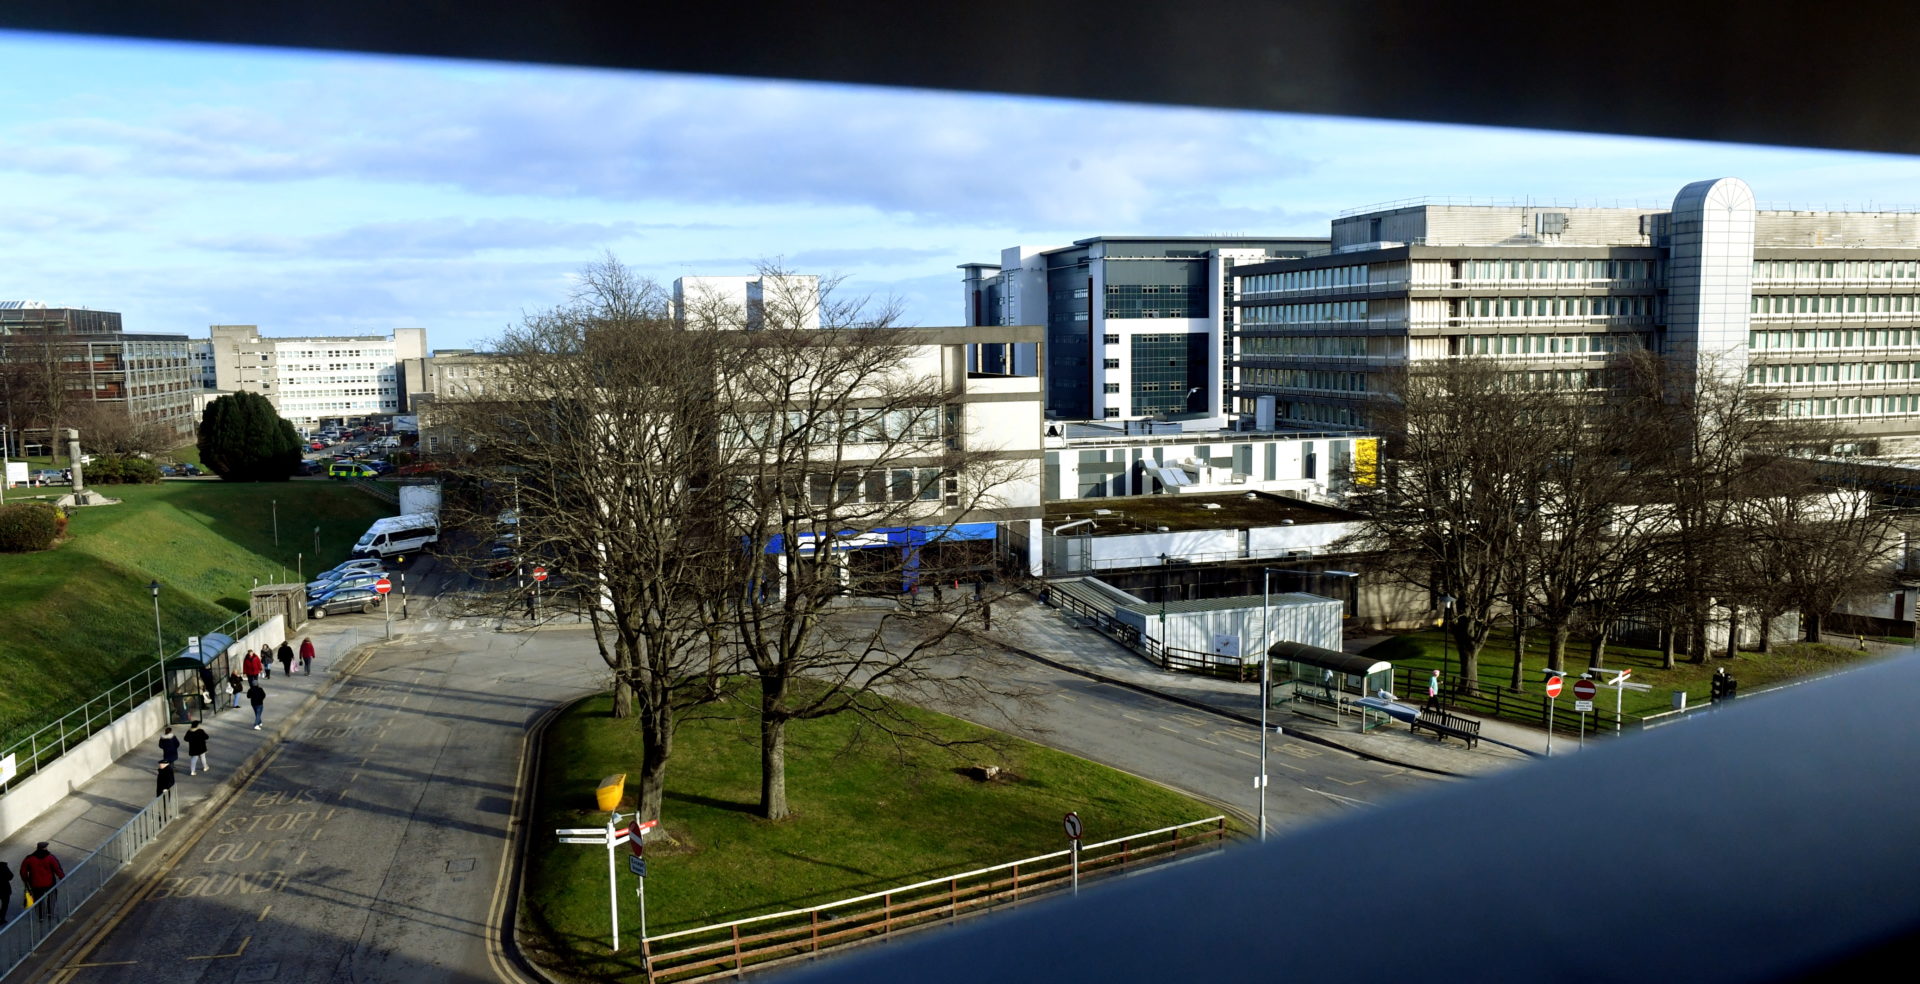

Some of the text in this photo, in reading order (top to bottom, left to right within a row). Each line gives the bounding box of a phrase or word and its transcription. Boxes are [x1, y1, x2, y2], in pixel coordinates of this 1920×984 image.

[253, 789, 316, 807] BUS
[218, 811, 316, 834] STOP
[203, 839, 286, 863] OUT
[153, 871, 285, 899] BOUND
